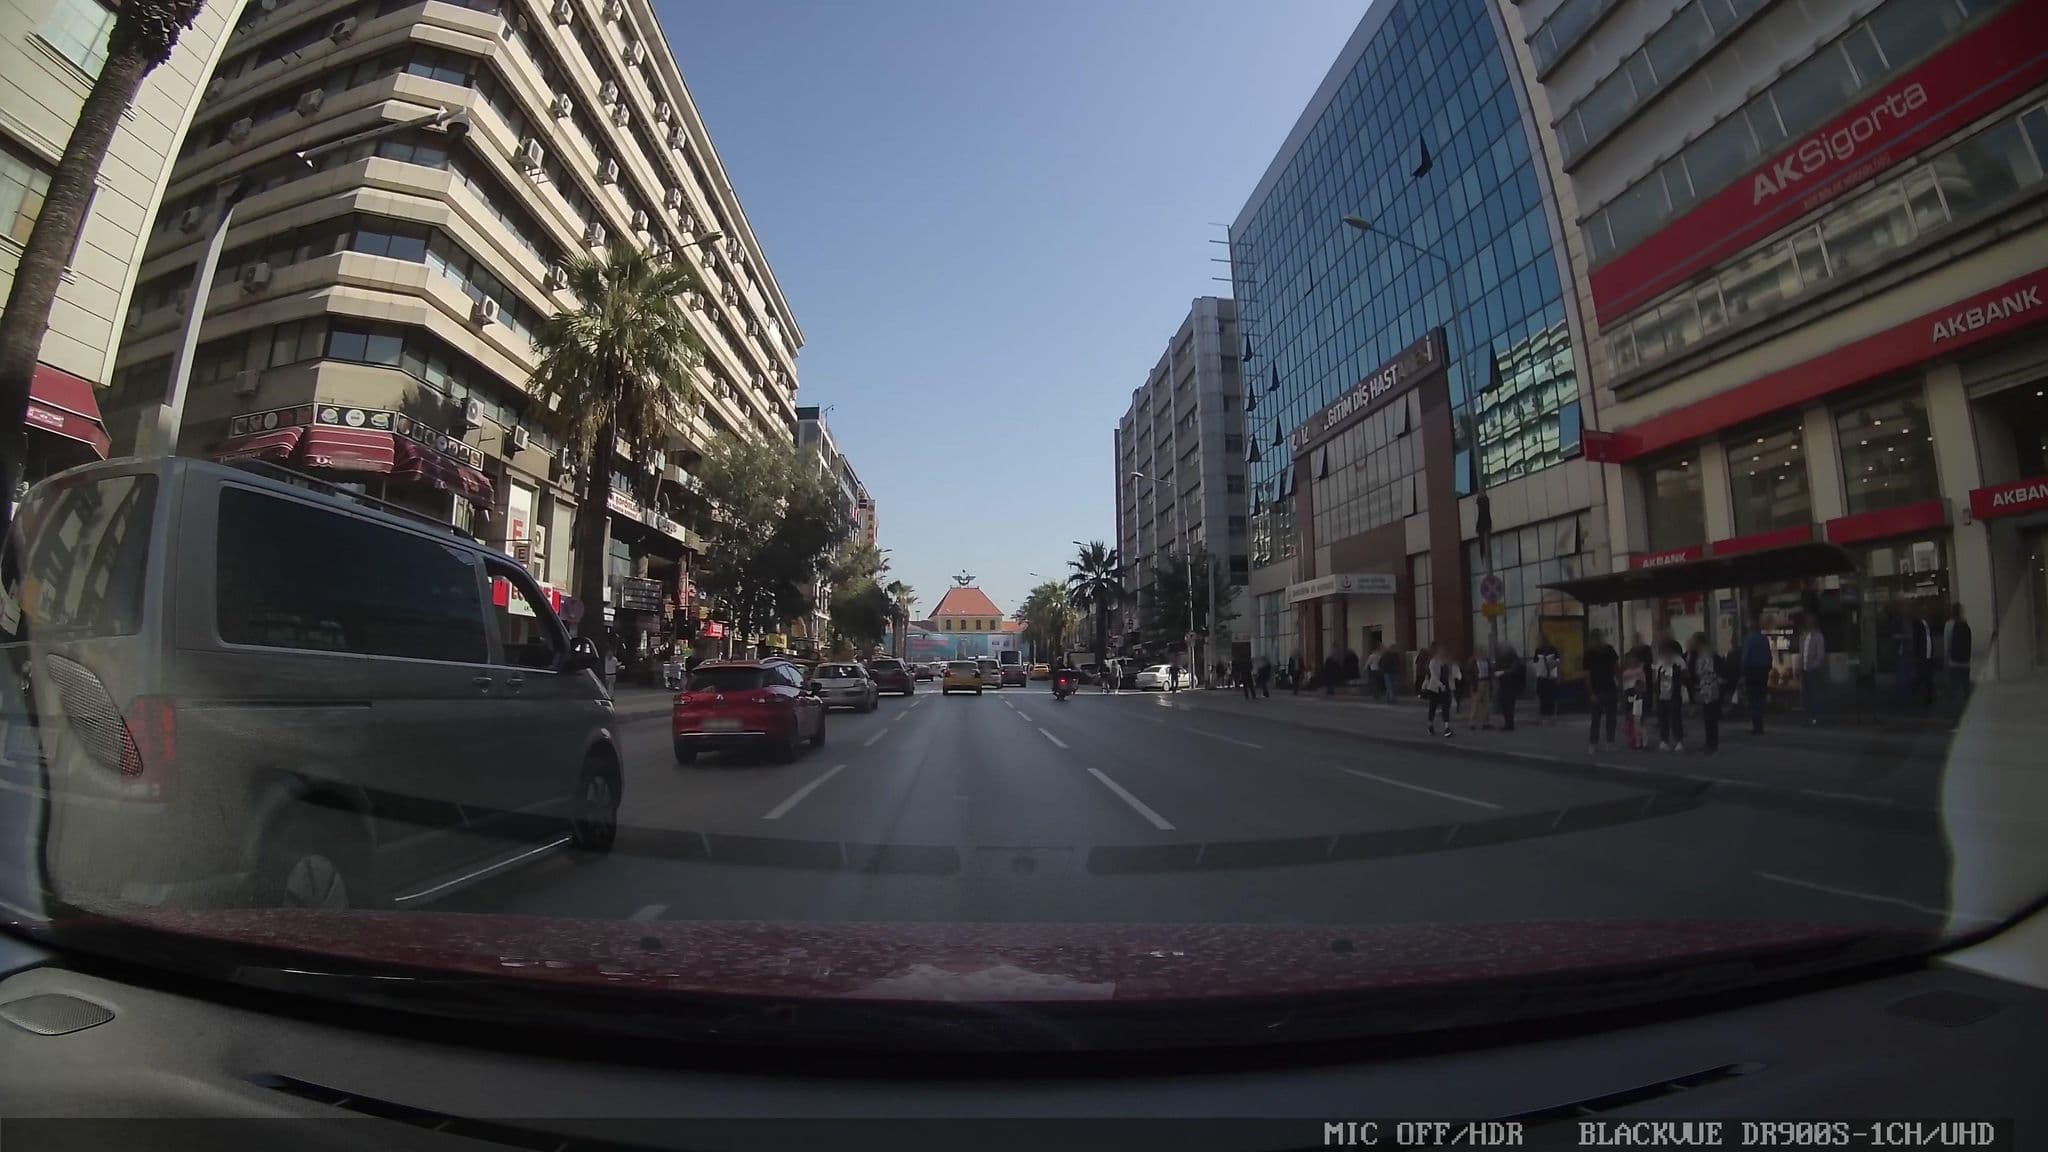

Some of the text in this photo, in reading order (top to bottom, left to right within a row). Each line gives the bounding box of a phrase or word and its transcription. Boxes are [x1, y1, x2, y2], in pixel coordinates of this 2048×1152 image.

[1753, 82, 1928, 206] AKSigorta
[1932, 285, 2043, 344] AKBANK
[1642, 551, 1687, 569] AKBANK
